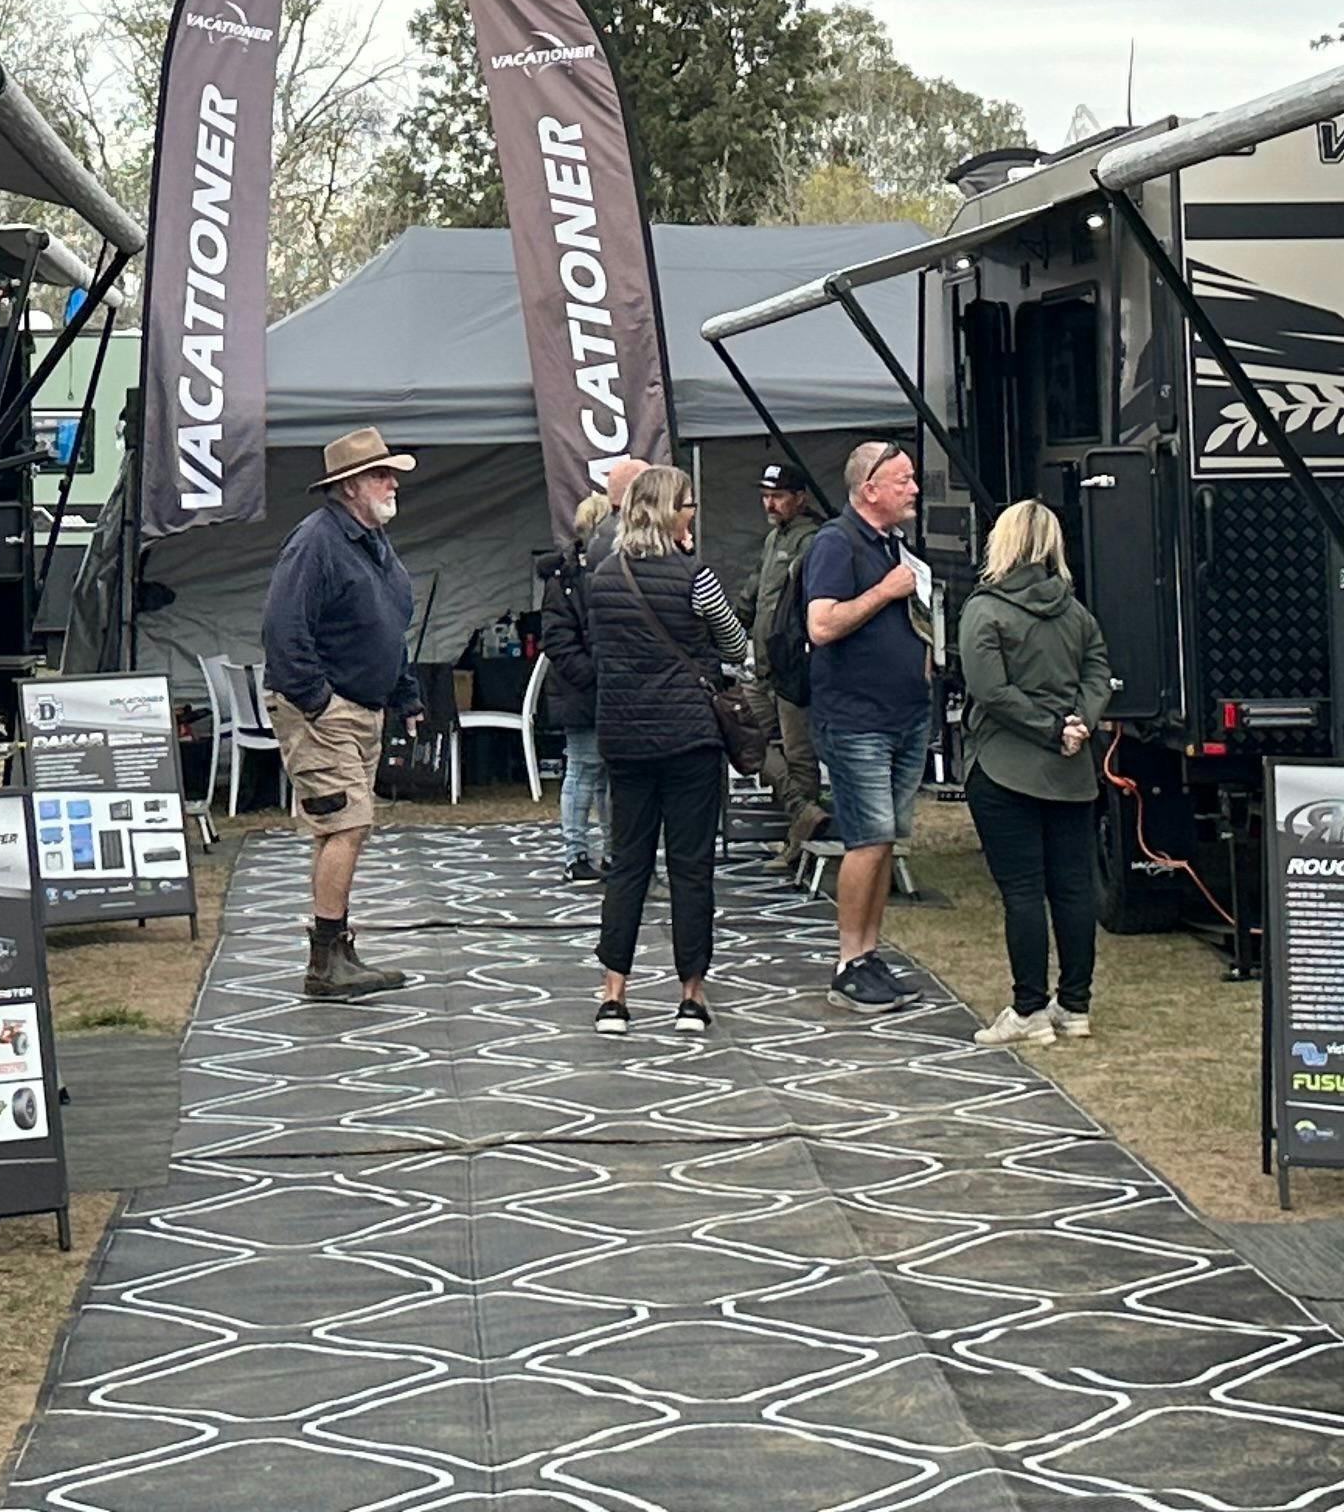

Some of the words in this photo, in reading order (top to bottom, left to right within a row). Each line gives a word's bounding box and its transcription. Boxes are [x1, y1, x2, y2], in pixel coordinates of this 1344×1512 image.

[186, 12, 274, 43] VACATIONER
[491, 44, 596, 70] VACATIONER
[177, 82, 239, 511] VACATIONER
[537, 114, 632, 491] ACATIONER
[32, 732, 105, 750] DAKAR
